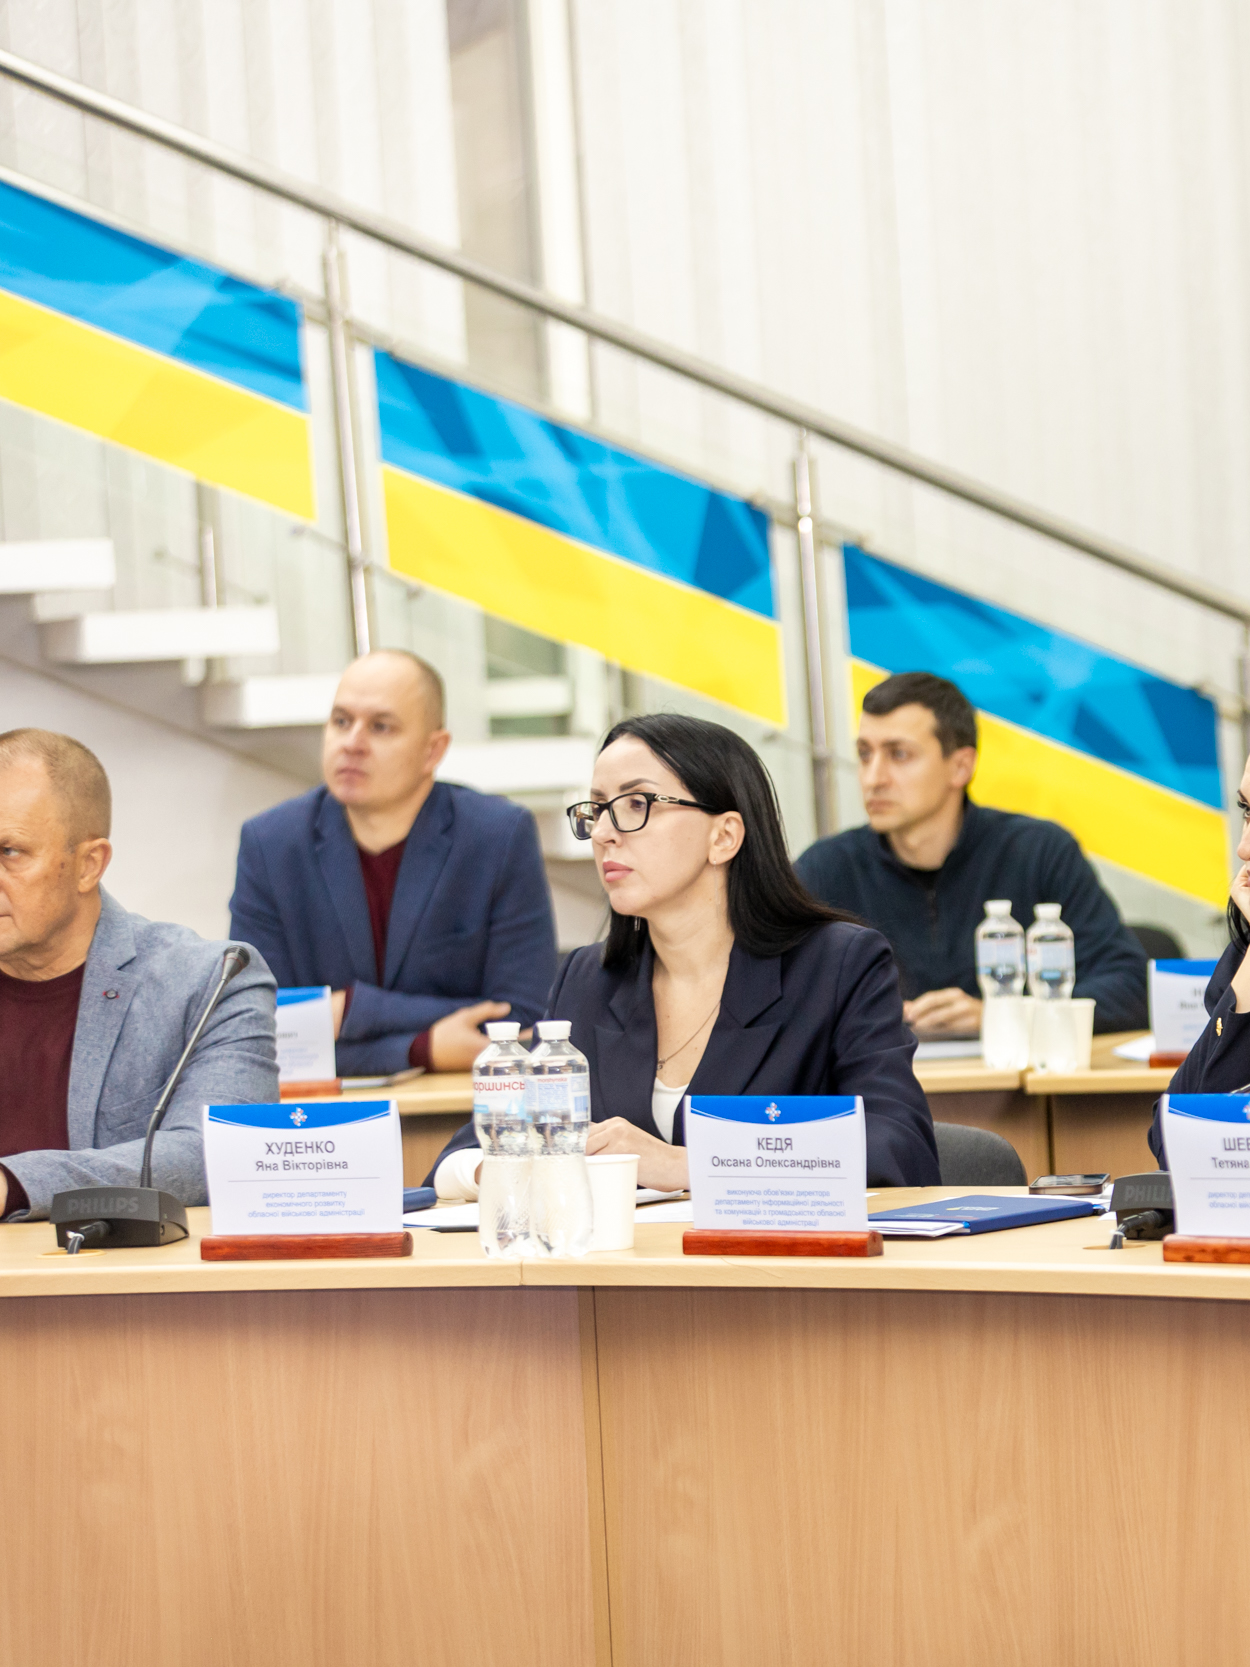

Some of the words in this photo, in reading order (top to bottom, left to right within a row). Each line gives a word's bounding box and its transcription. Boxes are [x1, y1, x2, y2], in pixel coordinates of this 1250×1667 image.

[265, 1140, 336, 1157] ХУДЕНКО
[757, 1137, 793, 1153] КЕДЯ
[255, 1160, 279, 1172] Яна
[282, 1159, 349, 1173] Вікторівна
[711, 1155, 752, 1168] Оксана
[755, 1156, 841, 1171] Олександрівна
[1211, 1157, 1250, 1169] Тетяна
[262, 1191, 295, 1200] директор
[297, 1190, 347, 1199] департаменту
[796, 1189, 831, 1198] директора
[67, 1197, 139, 1214] PHILIPS
[314, 1200, 346, 1208] розвитку
